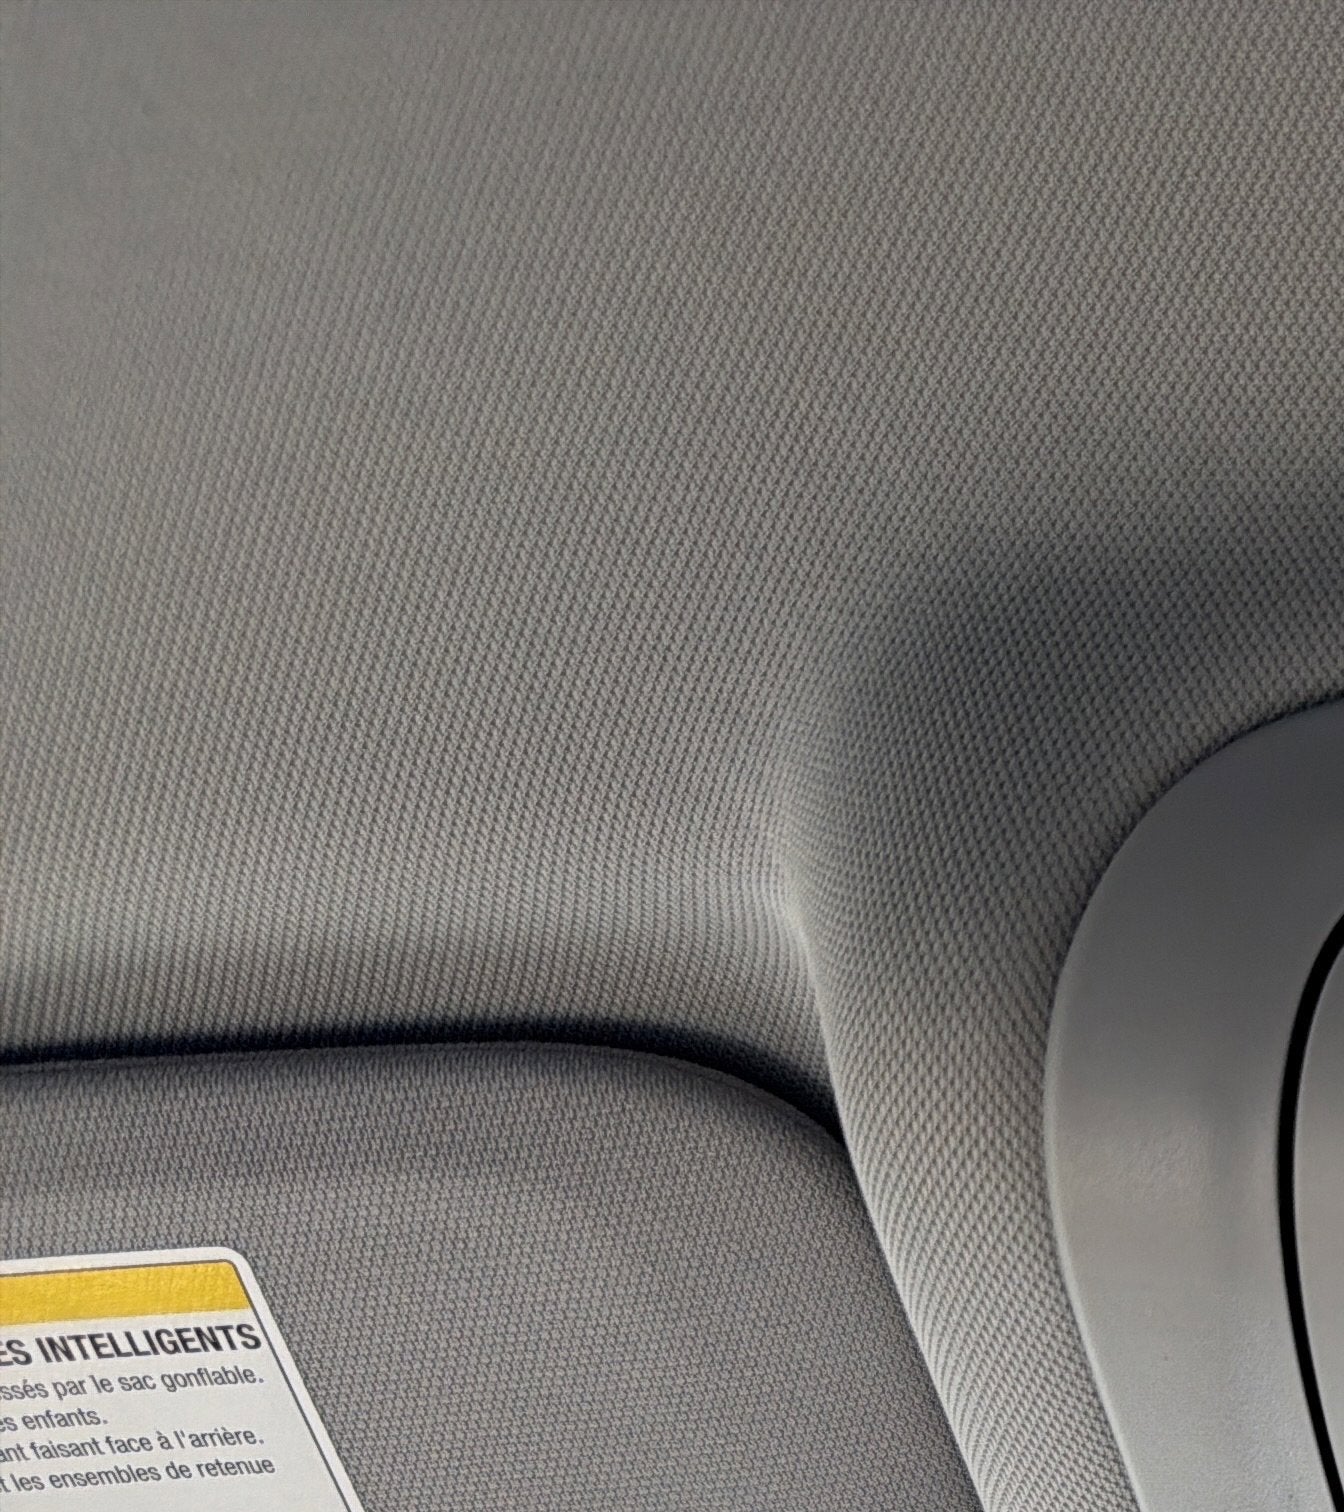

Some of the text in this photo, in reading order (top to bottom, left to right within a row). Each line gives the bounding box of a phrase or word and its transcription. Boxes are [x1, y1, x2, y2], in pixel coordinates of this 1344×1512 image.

[35, 1324, 261, 1363] INTELLIGENTS
[52, 1379, 88, 1401] par
[89, 1374, 114, 1393] le
[118, 1374, 156, 1392] sac
[161, 1364, 264, 1393] gonflable.
[21, 1407, 108, 1430] enfants.
[30, 1437, 106, 1460] faisant
[105, 1433, 152, 1454] face
[157, 1430, 173, 1450] à
[174, 1426, 264, 1449] l'arrière.
[9, 1473, 45, 1492] les
[48, 1463, 161, 1489] ensembles
[164, 1461, 193, 1480] de
[195, 1457, 275, 1477] retenue
